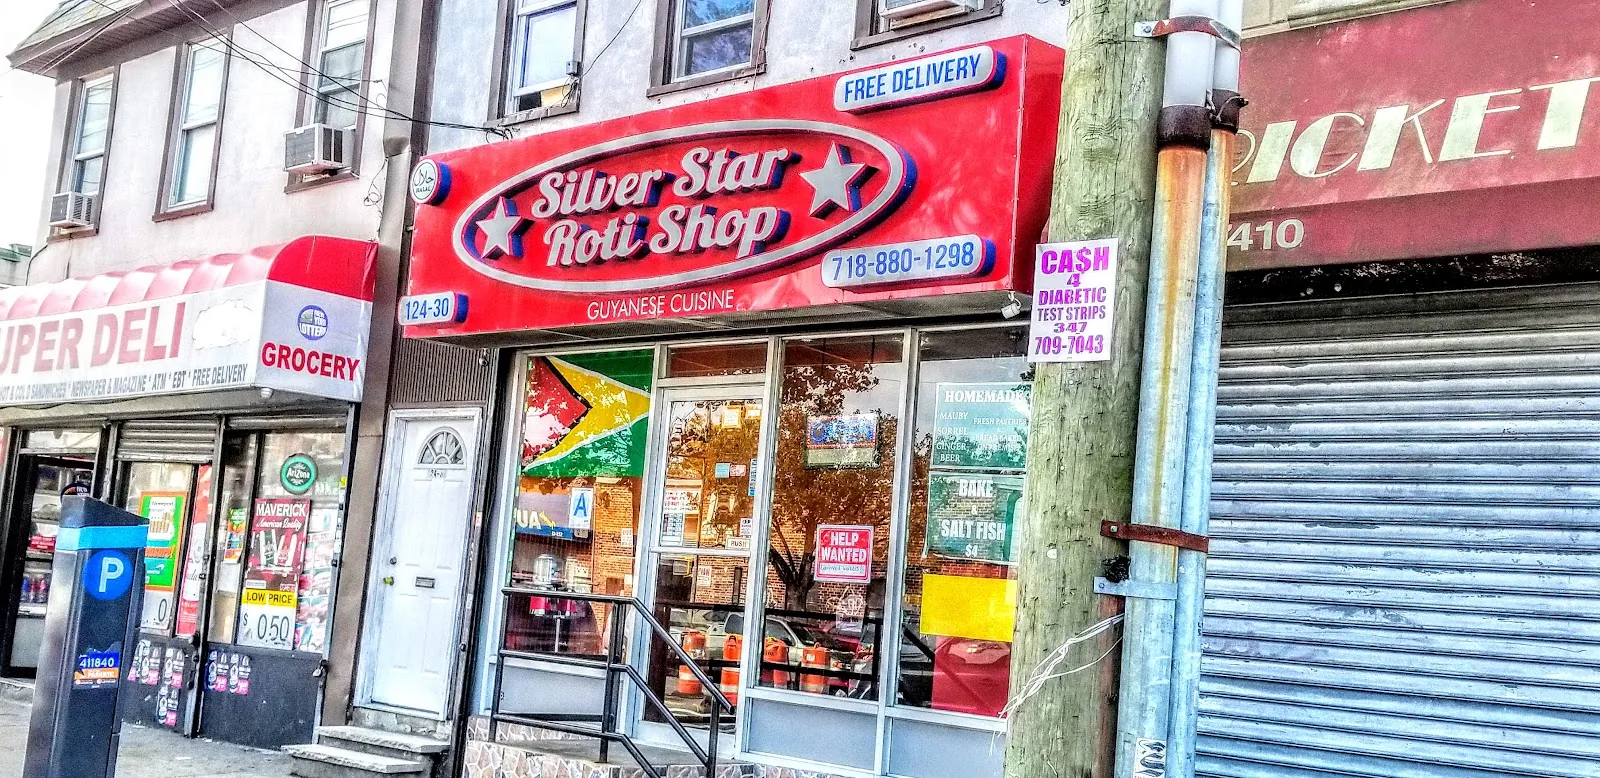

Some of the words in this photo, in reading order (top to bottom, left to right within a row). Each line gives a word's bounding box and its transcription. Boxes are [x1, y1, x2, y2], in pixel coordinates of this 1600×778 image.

[844, 73, 887, 103] FREE
[892, 53, 982, 93] DELIVERY
[531, 170, 665, 219] Silver
[673, 147, 790, 198] Star
[543, 212, 644, 267] Roti
[649, 203, 778, 260] Shop
[1226, 219, 1304, 251] 410
[831, 241, 975, 281] 718-880-1298
[1041, 245, 1110, 276] CA$H
[1067, 273, 1081, 287] 4
[587, 296, 665, 320] GUYANESE
[670, 289, 735, 313] CUISINE
[1038, 287, 1107, 306] DIABETIC
[405, 298, 449, 321] 124-30
[1037, 308, 1064, 322] TEST
[1065, 305, 1106, 321] STRIPS
[1053, 321, 1088, 334] 347
[0, 318, 83, 374] UPER
[90, 302, 186, 367] DELI
[1035, 334, 1104, 355] 709-7043
[261, 341, 361, 382] GROCERY
[70, 379, 106, 397] NEWSPAPER
[107, 378, 112, 394] &
[113, 375, 147, 394] MAGAZINE
[152, 373, 167, 391] ATM
[172, 370, 187, 388] EBT
[192, 367, 211, 386] FREE
[211, 363, 248, 384] DELIVERY
[944, 390, 1025, 403] HOMEMADE
[939, 411, 968, 420] MAUBY
[973, 417, 994, 425] FRESH
[937, 427, 968, 435] SORREL
[975, 434, 997, 442] BREAD
[999, 434, 1021, 442] BAKED
[936, 442, 966, 451] GINGER
[939, 453, 961, 462] BEER
[959, 479, 994, 497] BAKE
[255, 503, 308, 517] MAVERICK
[573, 492, 588, 517] A
[971, 505, 978, 515] &
[256, 517, 283, 529] American
[283, 517, 303, 532] Quality
[941, 519, 974, 539] SALT
[976, 521, 1006, 540] FISH
[730, 540, 747, 548] PUSH
[830, 531, 860, 546] HELP
[821, 547, 867, 562] WANTED
[965, 543, 979, 557] $4
[98, 557, 124, 592] P
[246, 591, 266, 602] LOW
[268, 593, 293, 604] PRICE
[243, 612, 248, 627] $
[257, 613, 290, 642] 0.50
[80, 657, 115, 668] 411840
